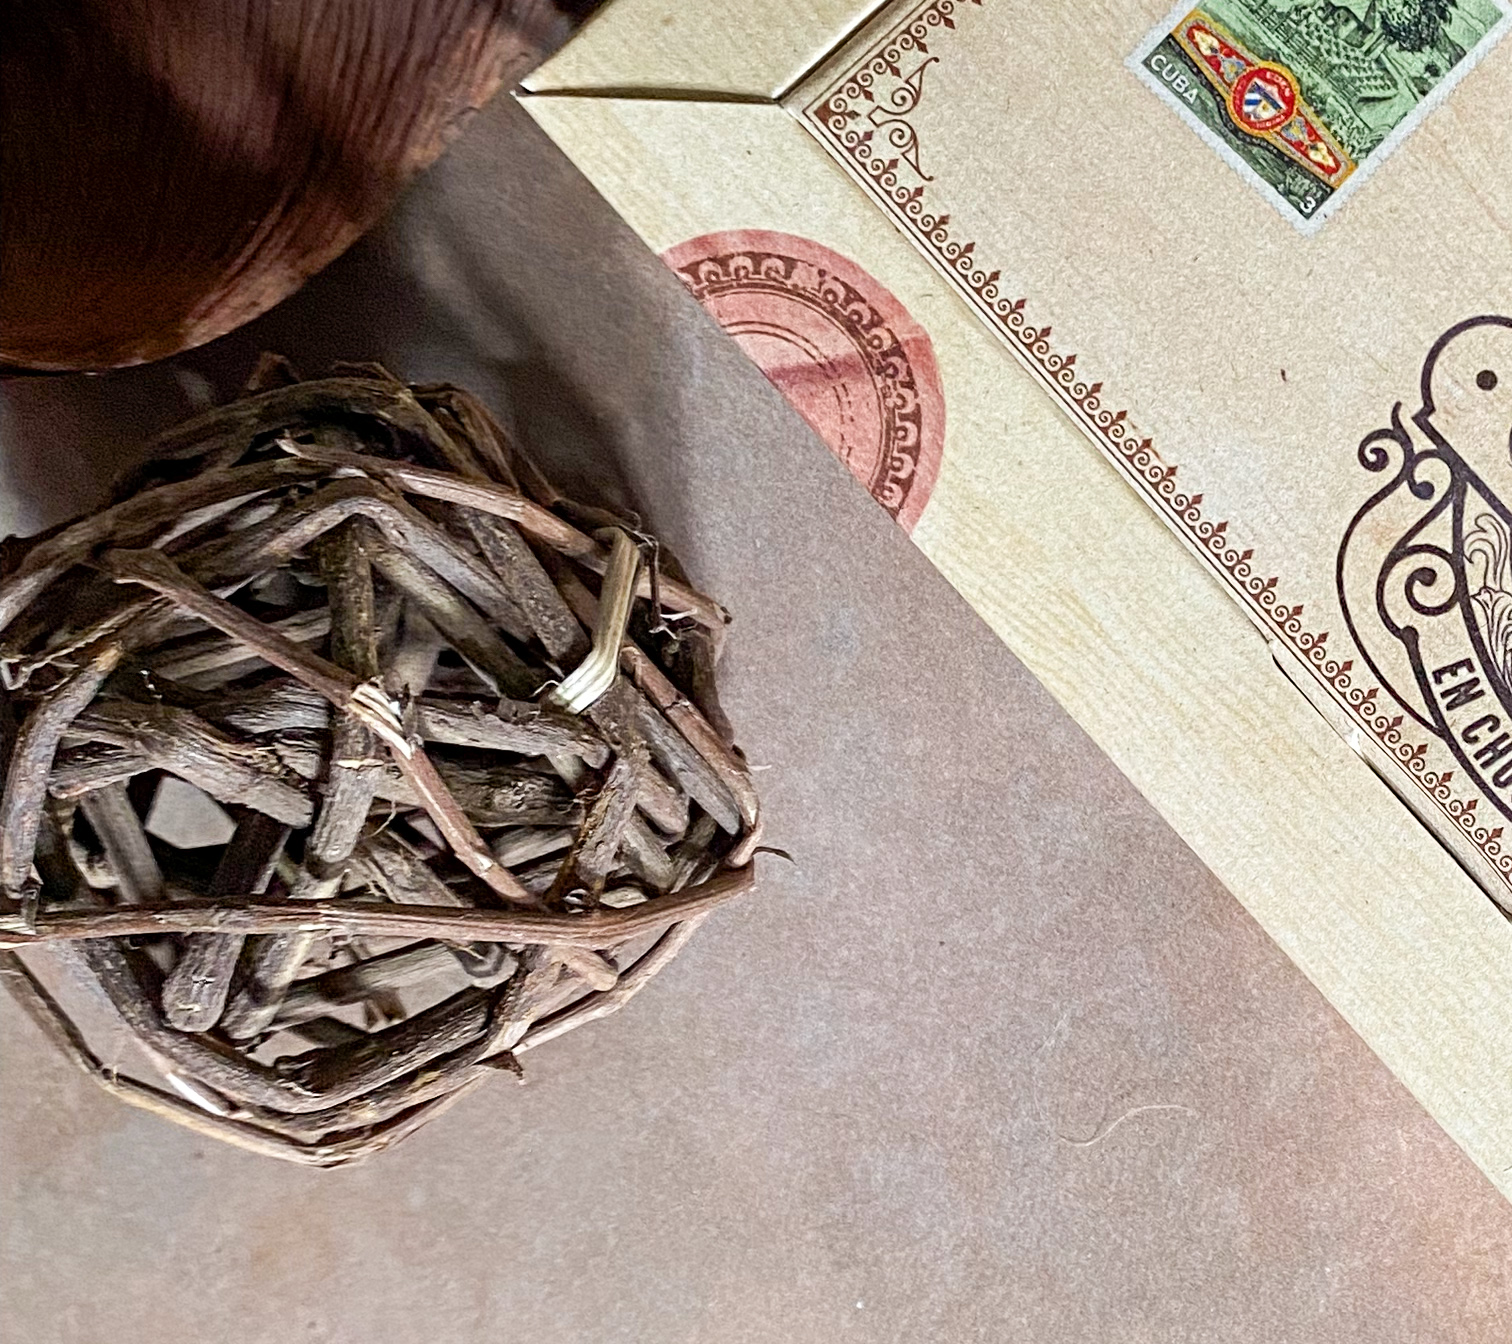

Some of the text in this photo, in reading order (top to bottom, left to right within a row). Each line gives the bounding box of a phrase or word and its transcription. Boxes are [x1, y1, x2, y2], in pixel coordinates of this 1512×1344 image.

[1150, 54, 1199, 105] CUBA
[1300, 196, 1317, 214] 3
[1432, 656, 1486, 711] EN
